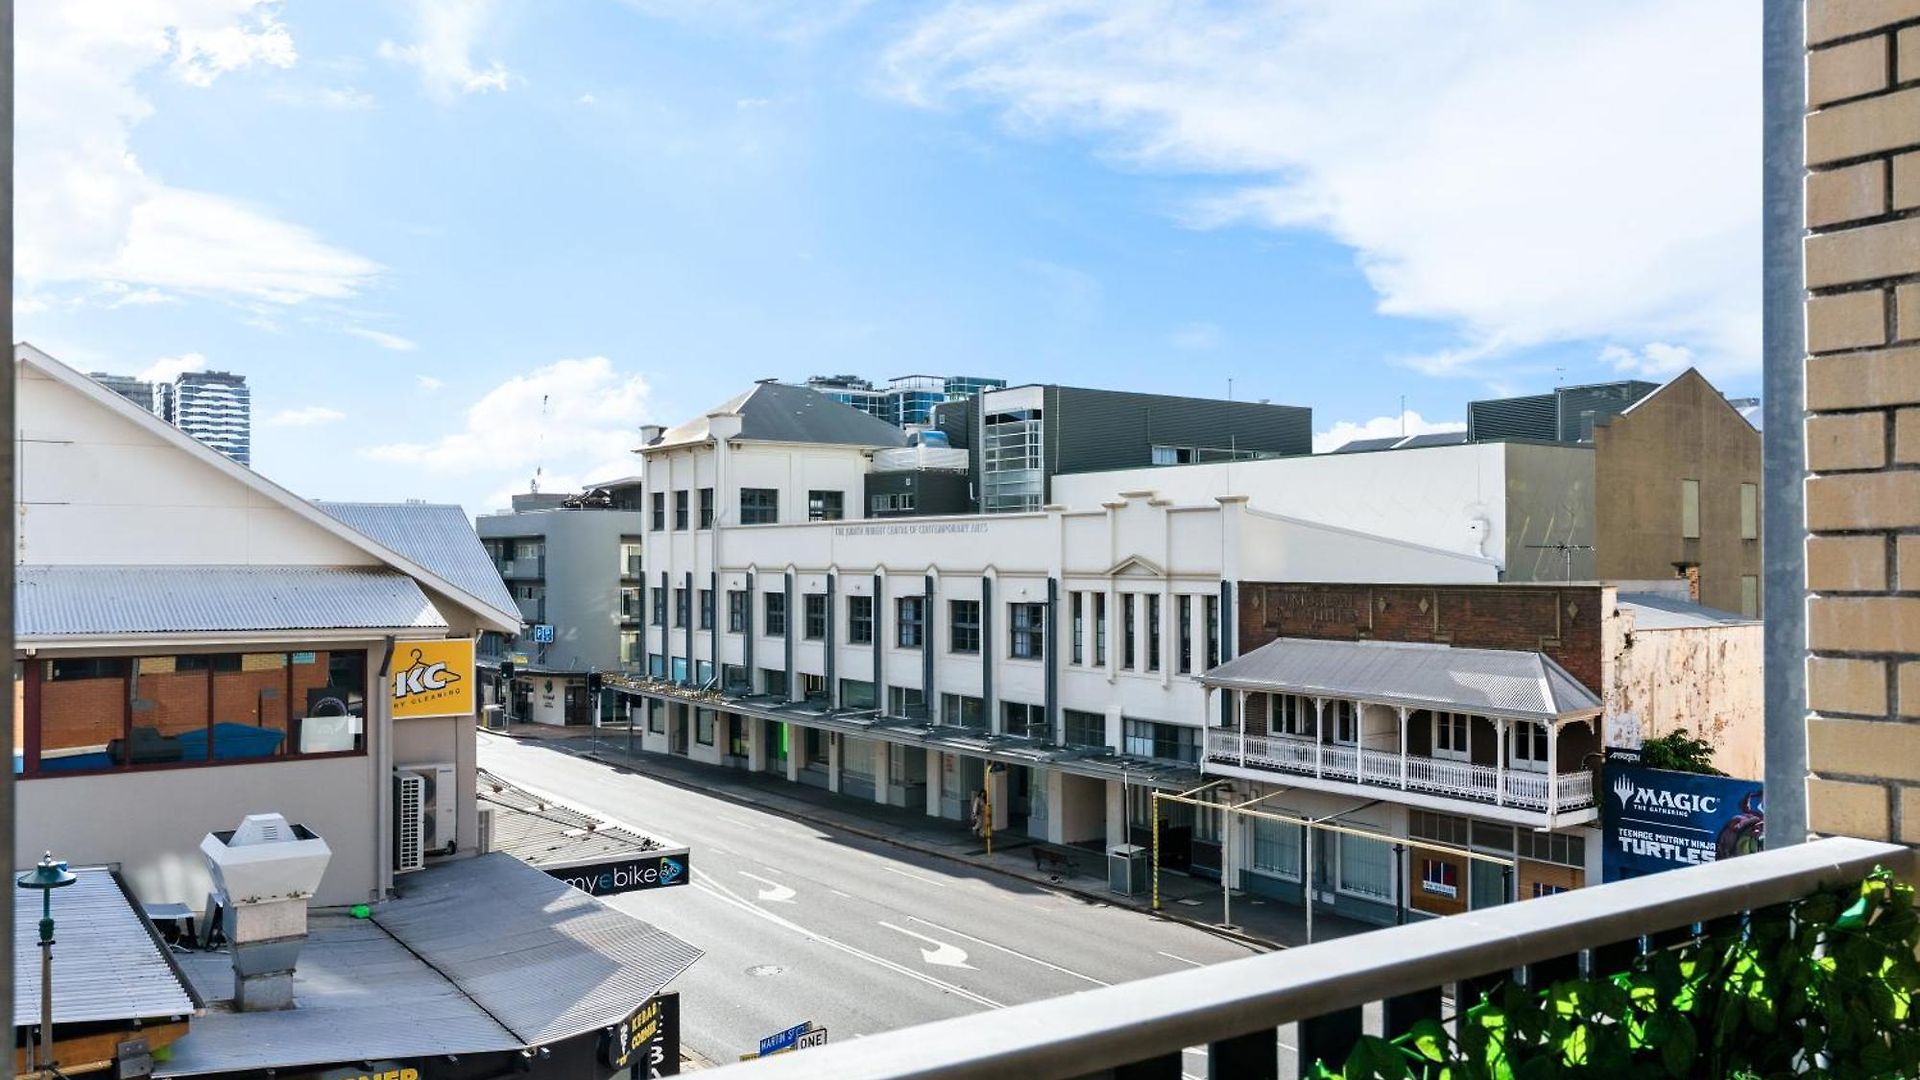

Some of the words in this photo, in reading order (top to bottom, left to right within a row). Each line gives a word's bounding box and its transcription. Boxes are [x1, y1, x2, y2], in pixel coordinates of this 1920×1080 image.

[411, 688, 461, 704] CLEANING
[1633, 787, 1717, 813] MAGIC
[1650, 806, 1689, 817] GATHERING
[1618, 828, 1654, 841] TEENAGE
[1655, 833, 1690, 845] MUTANT
[1690, 839, 1717, 850] NINJA
[1618, 836, 1717, 865] TURTLES
[761, 1032, 786, 1050] MARTIN
[800, 1033, 823, 1049] ONE
